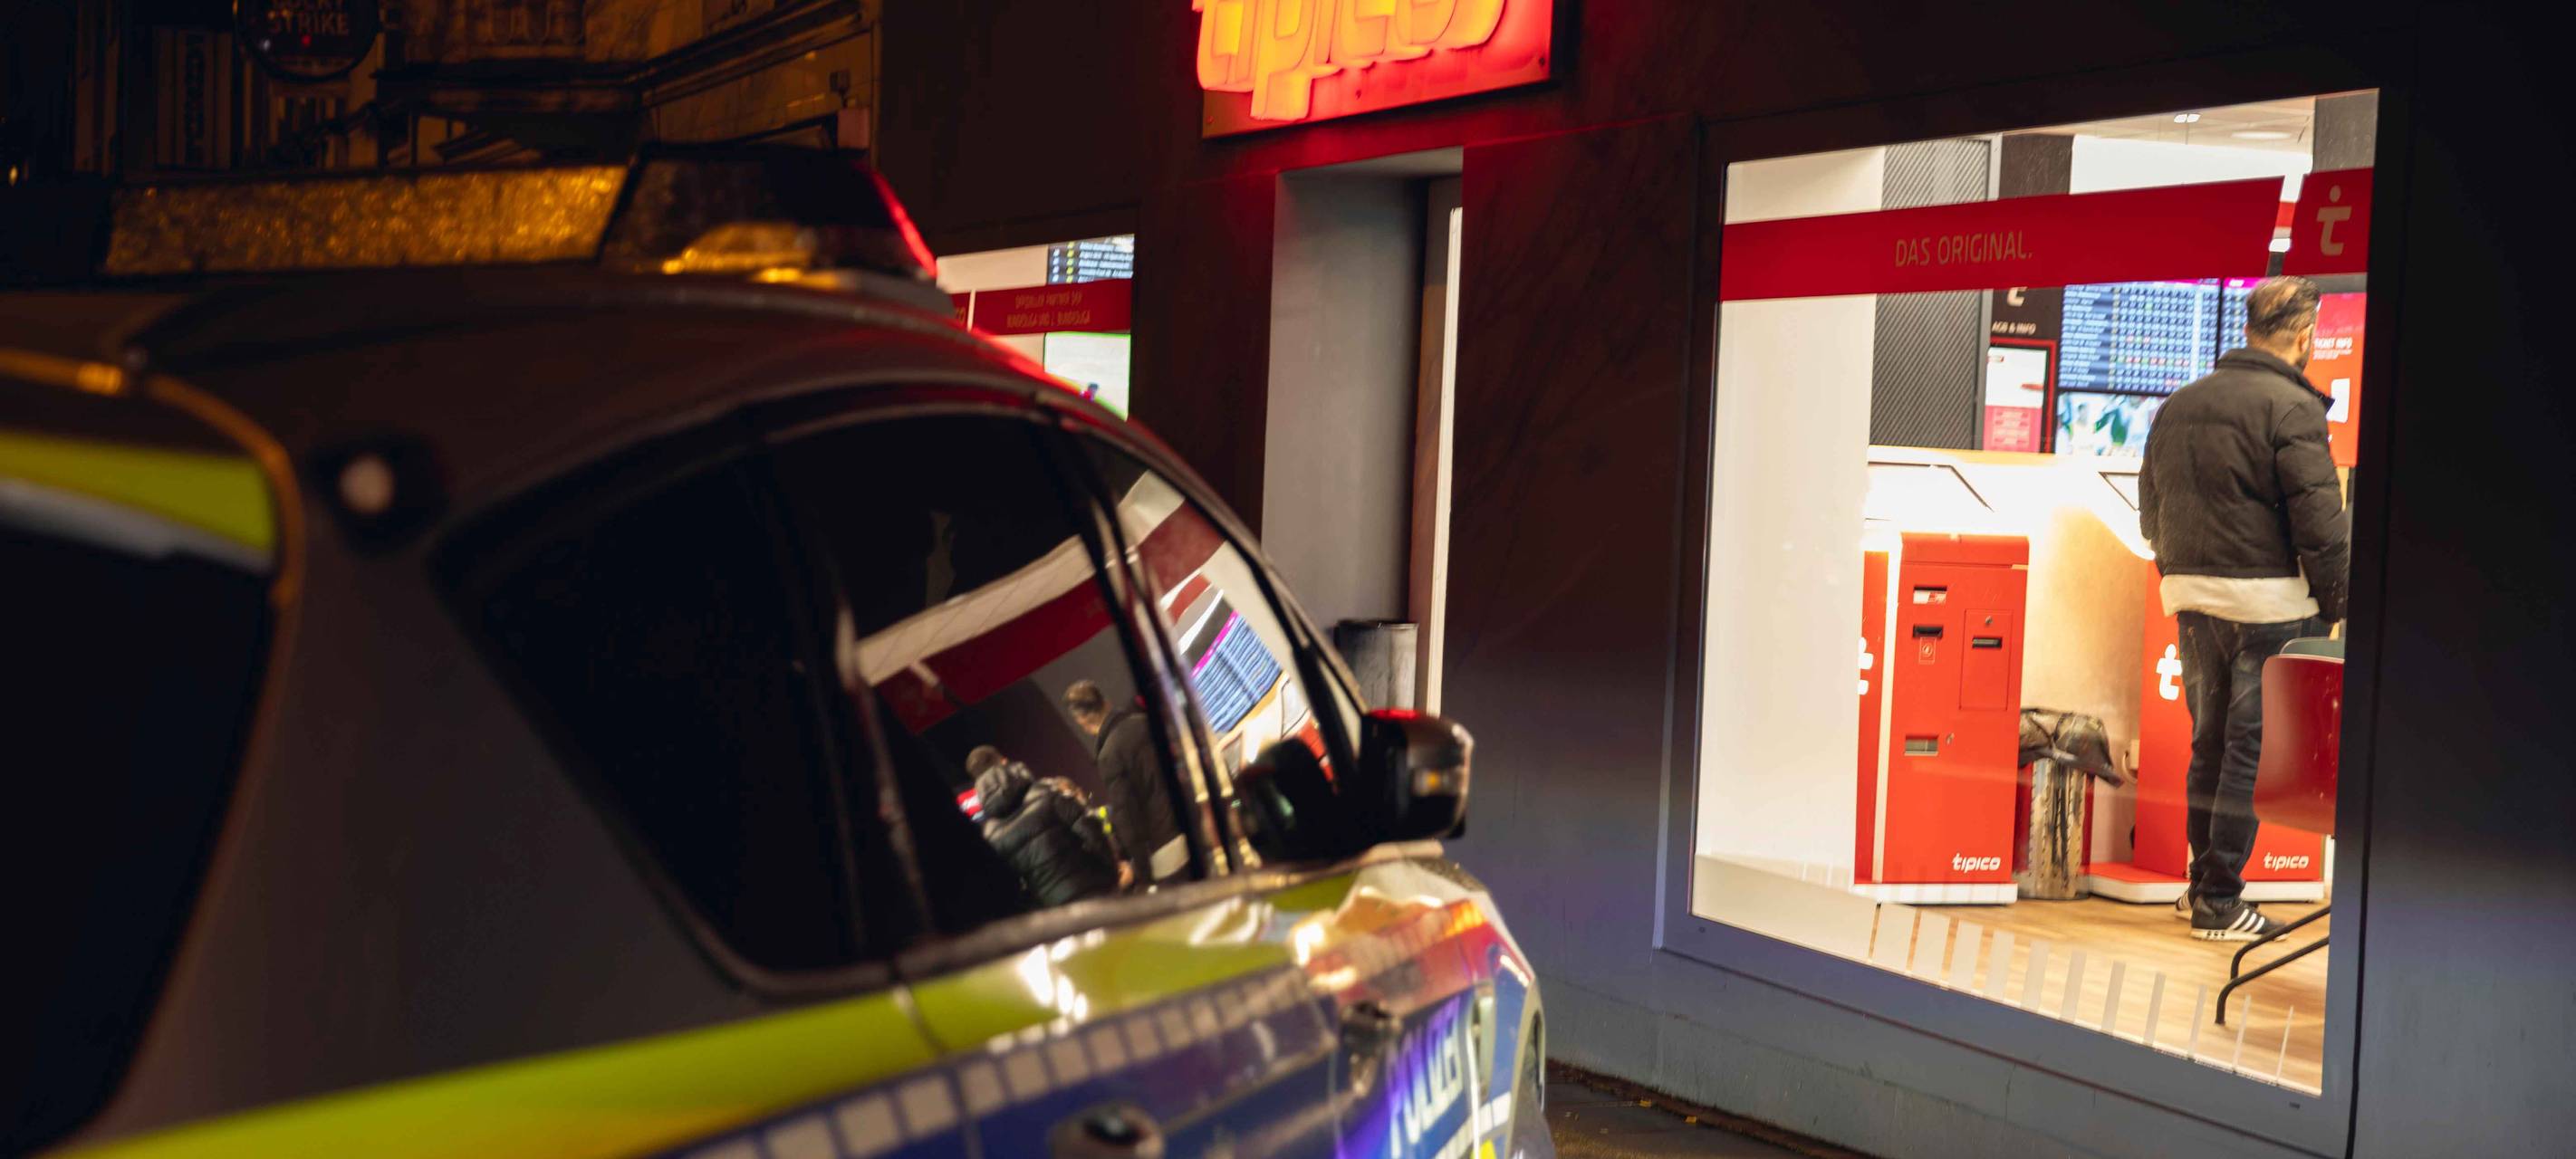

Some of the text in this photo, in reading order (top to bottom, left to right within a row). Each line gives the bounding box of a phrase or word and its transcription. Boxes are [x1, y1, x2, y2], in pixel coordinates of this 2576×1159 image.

[1895, 230, 2033, 267] DAS ORIGINAL.
[1952, 852, 2002, 874] tipico
[2264, 851, 2310, 872] tipico
